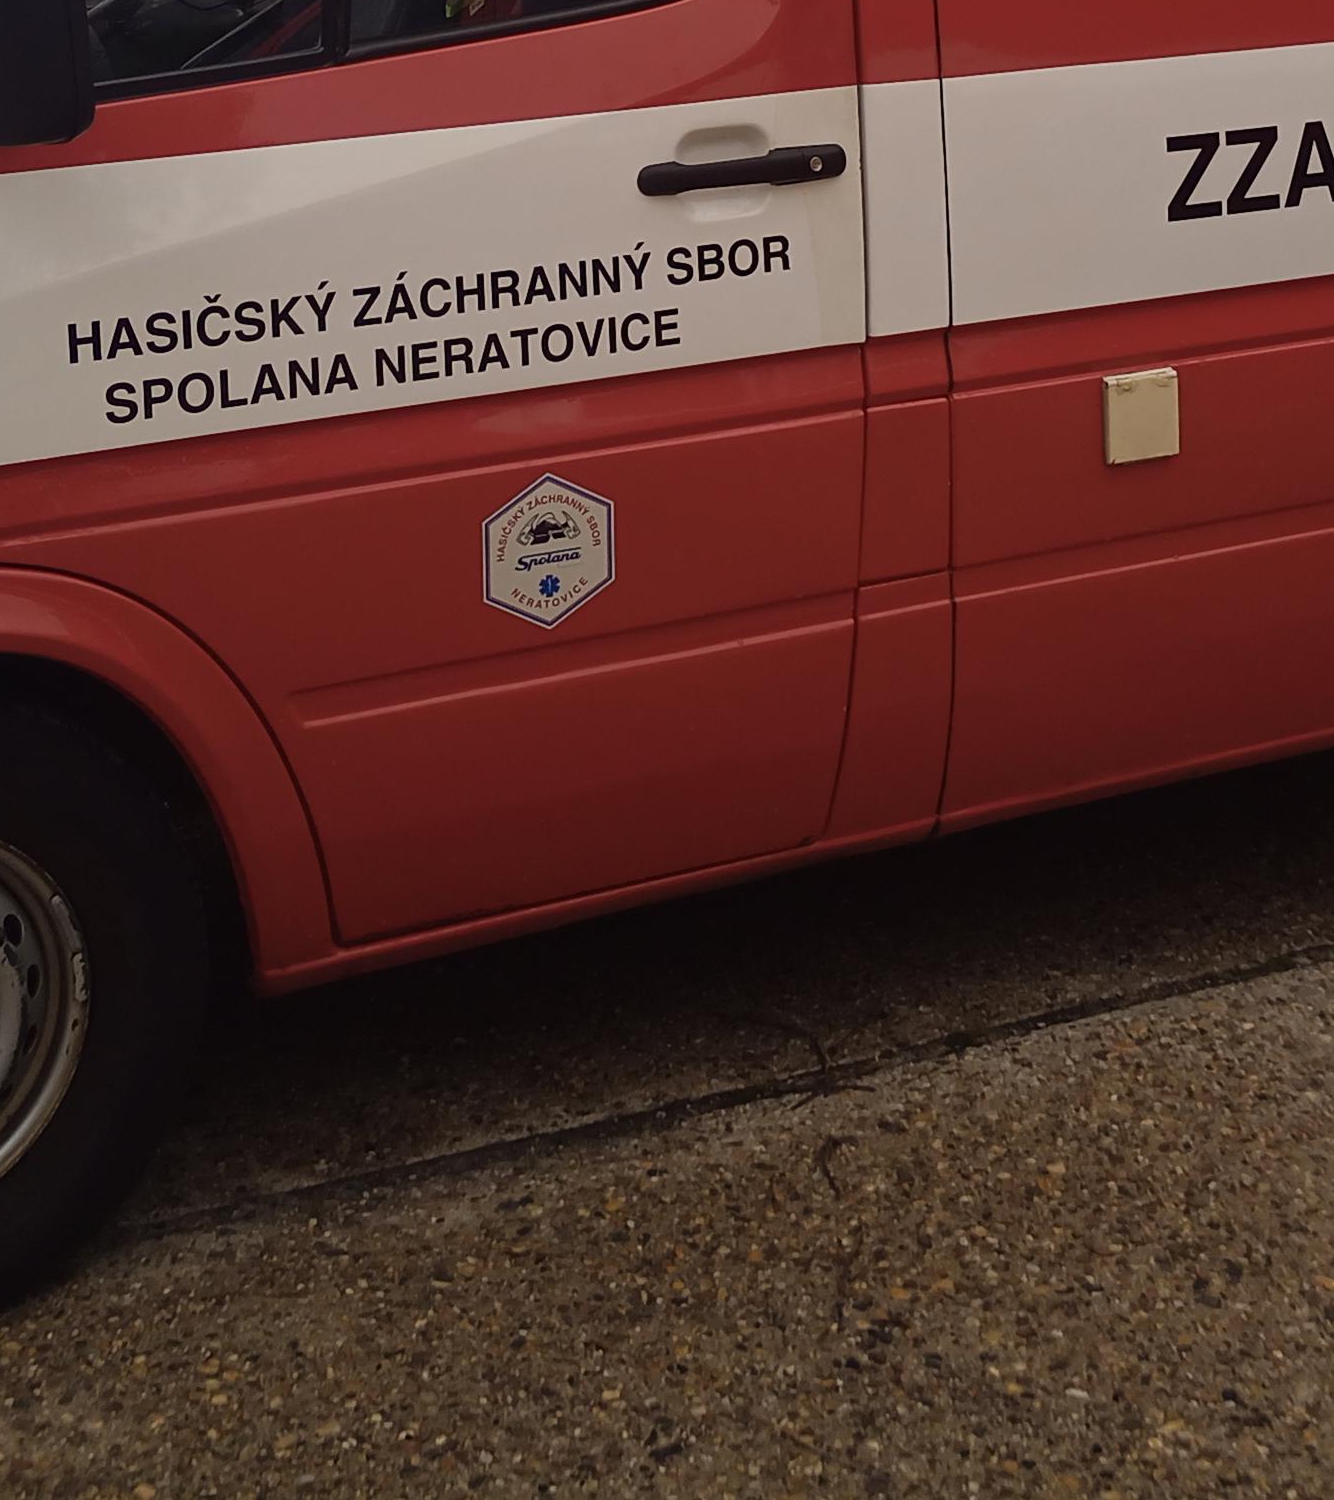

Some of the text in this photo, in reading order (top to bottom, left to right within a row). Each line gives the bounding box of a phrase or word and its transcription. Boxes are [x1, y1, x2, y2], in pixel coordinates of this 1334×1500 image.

[67, 235, 791, 365] HASIČSKÝ ZÁCHRANNÝ SBOR
[105, 308, 682, 425] SPOLANA NERATOVICE
[496, 493, 602, 563] HASIČSKÝ ZÁCHRANNÝ SBOR
[515, 547, 582, 572] Spolana
[511, 576, 589, 609] NERATOVICE
